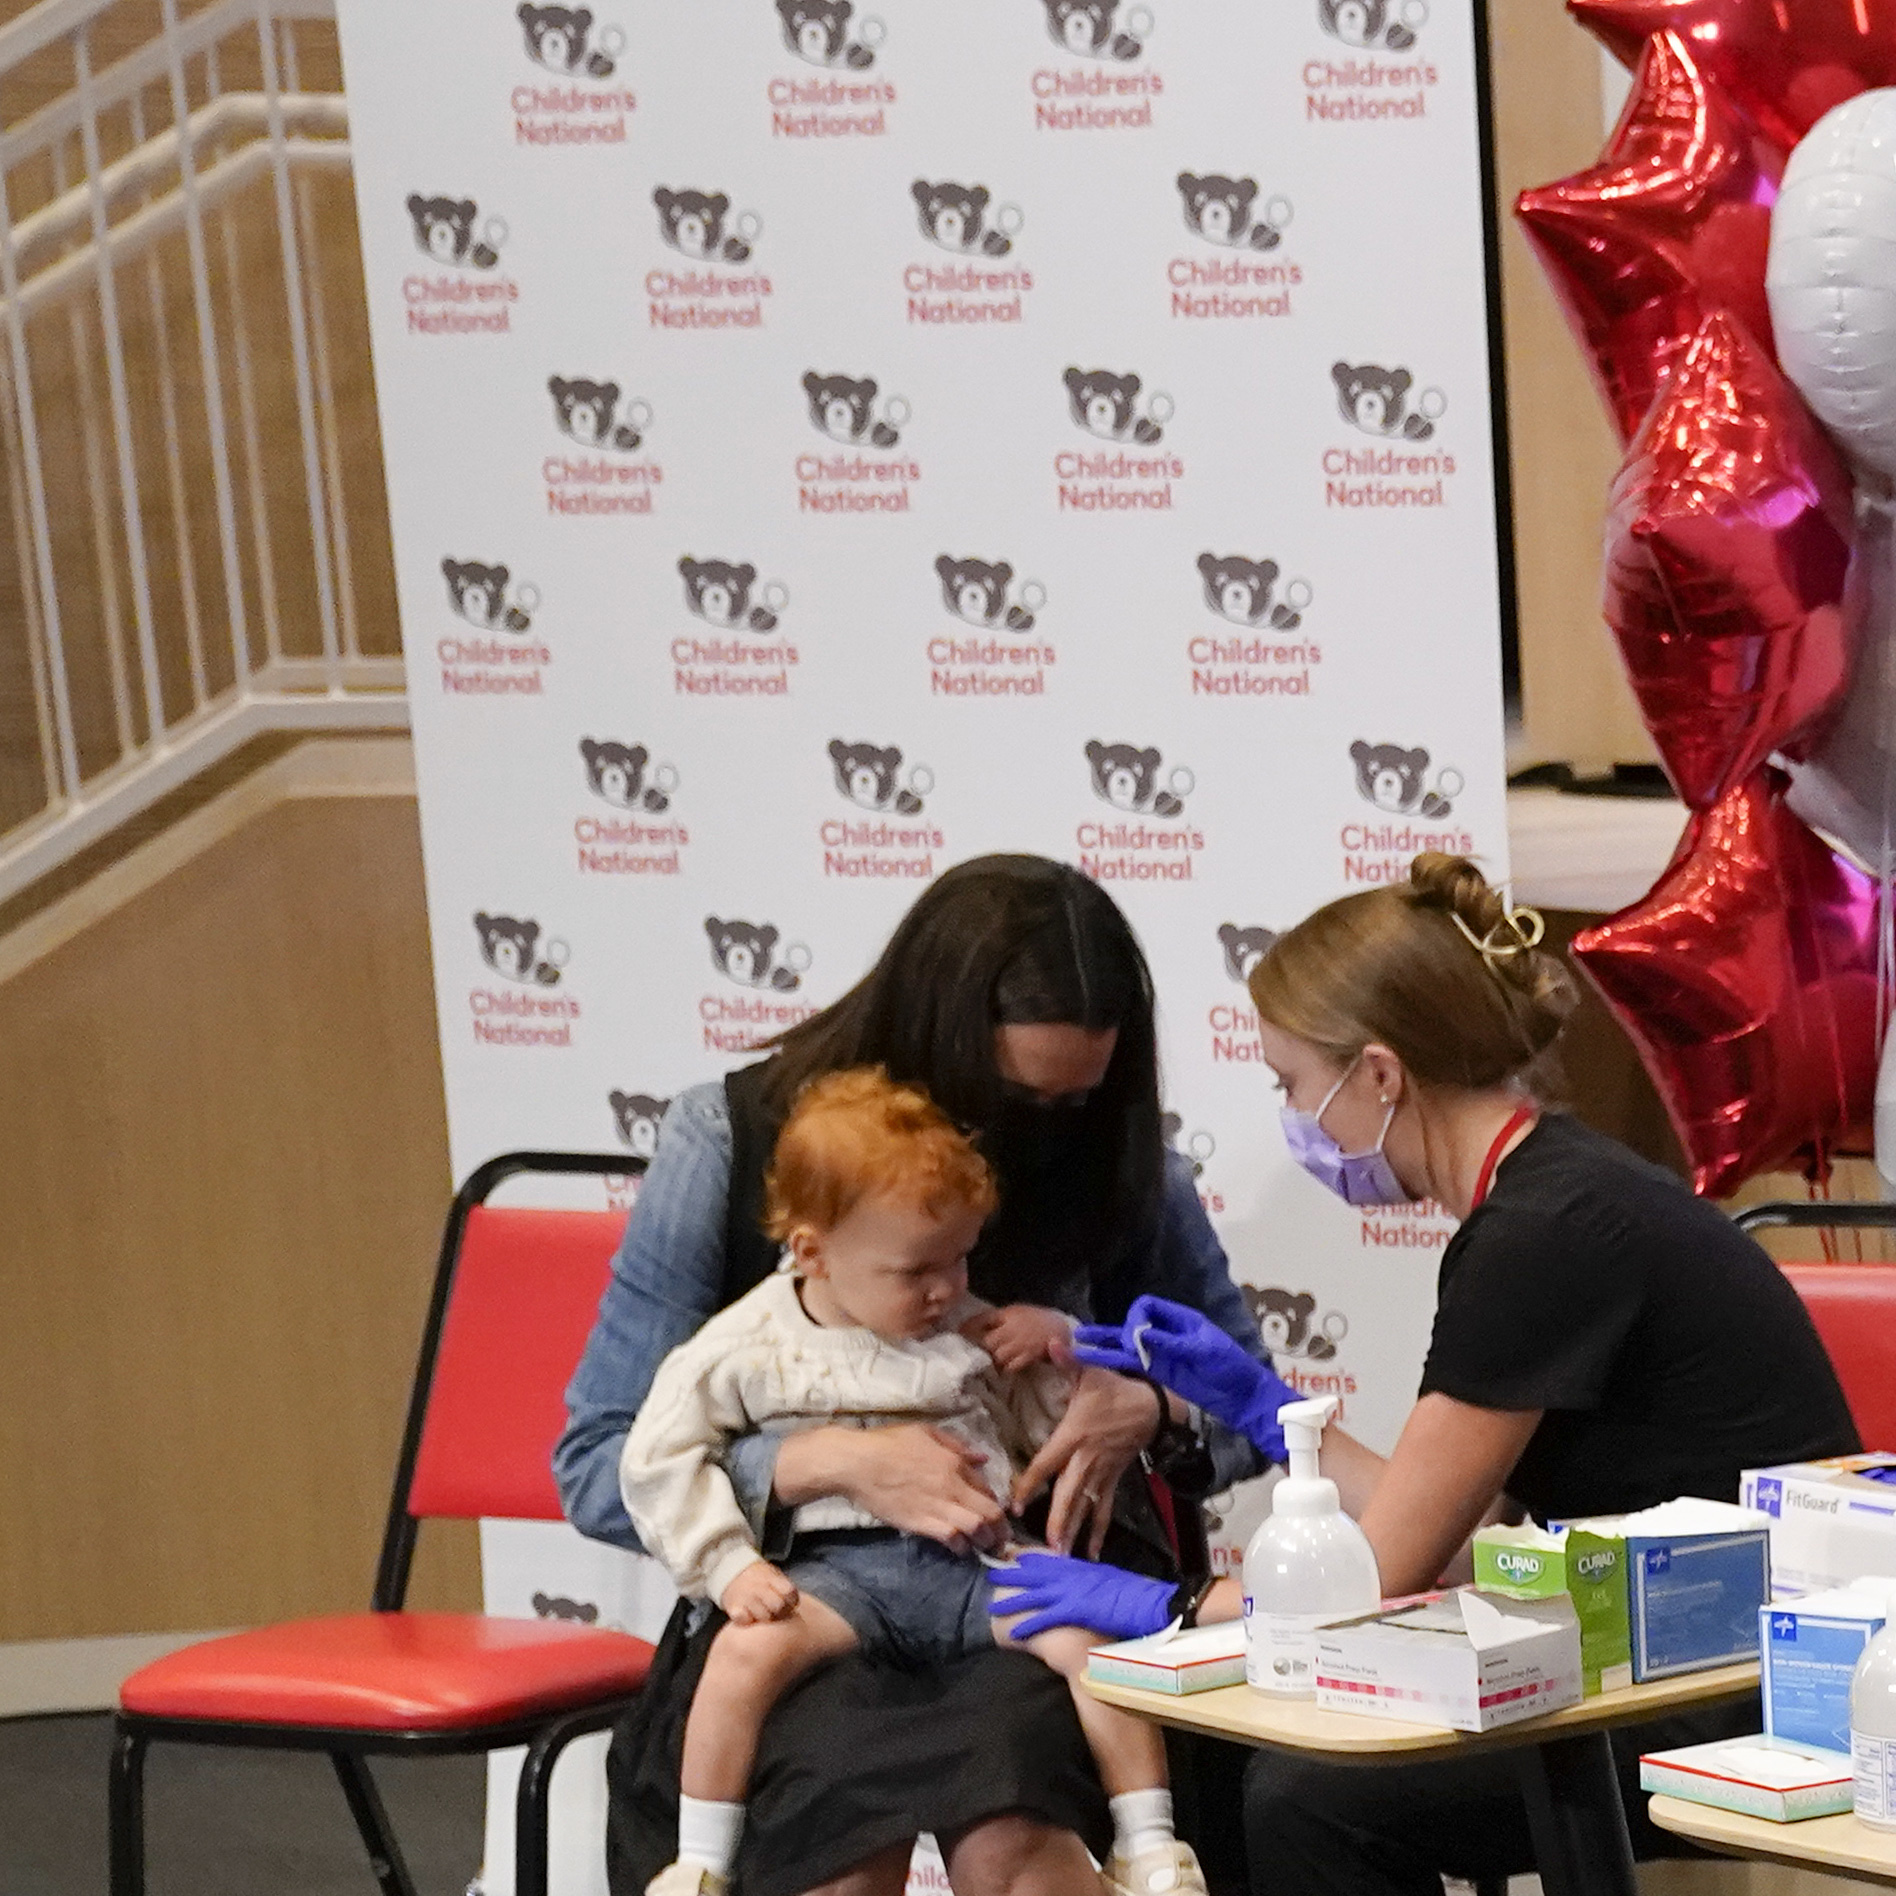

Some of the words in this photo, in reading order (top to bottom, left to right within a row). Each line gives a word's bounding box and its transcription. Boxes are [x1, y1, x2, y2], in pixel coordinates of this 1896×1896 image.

[1032, 71, 1163, 101] Children's
[1302, 61, 1437, 89] Children's
[511, 87, 637, 117] Children's
[769, 79, 896, 108] Children's
[1306, 93, 1424, 120] National
[773, 110, 884, 138] National
[1037, 102, 1152, 130] National
[516, 118, 626, 145] National
[646, 271, 772, 301] Children's
[904, 266, 1033, 293] Children's
[1168, 259, 1302, 289] Children's
[403, 277, 519, 306] Children's
[1171, 291, 1290, 318] National
[407, 308, 510, 335] National
[650, 301, 762, 328] National
[907, 299, 1021, 323] National
[542, 459, 664, 487] Children's
[796, 455, 920, 483] Children's
[1055, 452, 1185, 481] Children's
[1322, 448, 1456, 477] Children's
[547, 489, 652, 515] National
[799, 487, 909, 513] National
[1059, 484, 1172, 512] National
[1325, 481, 1442, 508] National
[438, 639, 551, 667] Children's
[671, 640, 799, 666] Children's
[927, 640, 1056, 668] Children's
[1188, 638, 1322, 665] Children's
[441, 669, 541, 695] National
[675, 670, 787, 695] National
[931, 670, 1045, 697] National
[1192, 670, 1310, 696] National
[574, 819, 690, 847] Children's
[819, 822, 945, 850] Children's
[1077, 823, 1204, 852] Children's
[1341, 825, 1473, 854] Children's
[578, 848, 680, 875] National
[822, 851, 934, 878] National
[1080, 853, 1192, 881] National
[1344, 856, 1412, 882] Natio
[471, 990, 581, 1018] Children's
[473, 1020, 571, 1046] National
[1361, 1220, 1455, 1249] Nation
[1282, 1367, 1358, 1394] dren's
[1497, 1552, 1540, 1573] CURAD
[1577, 1551, 1616, 1575] CURAD
